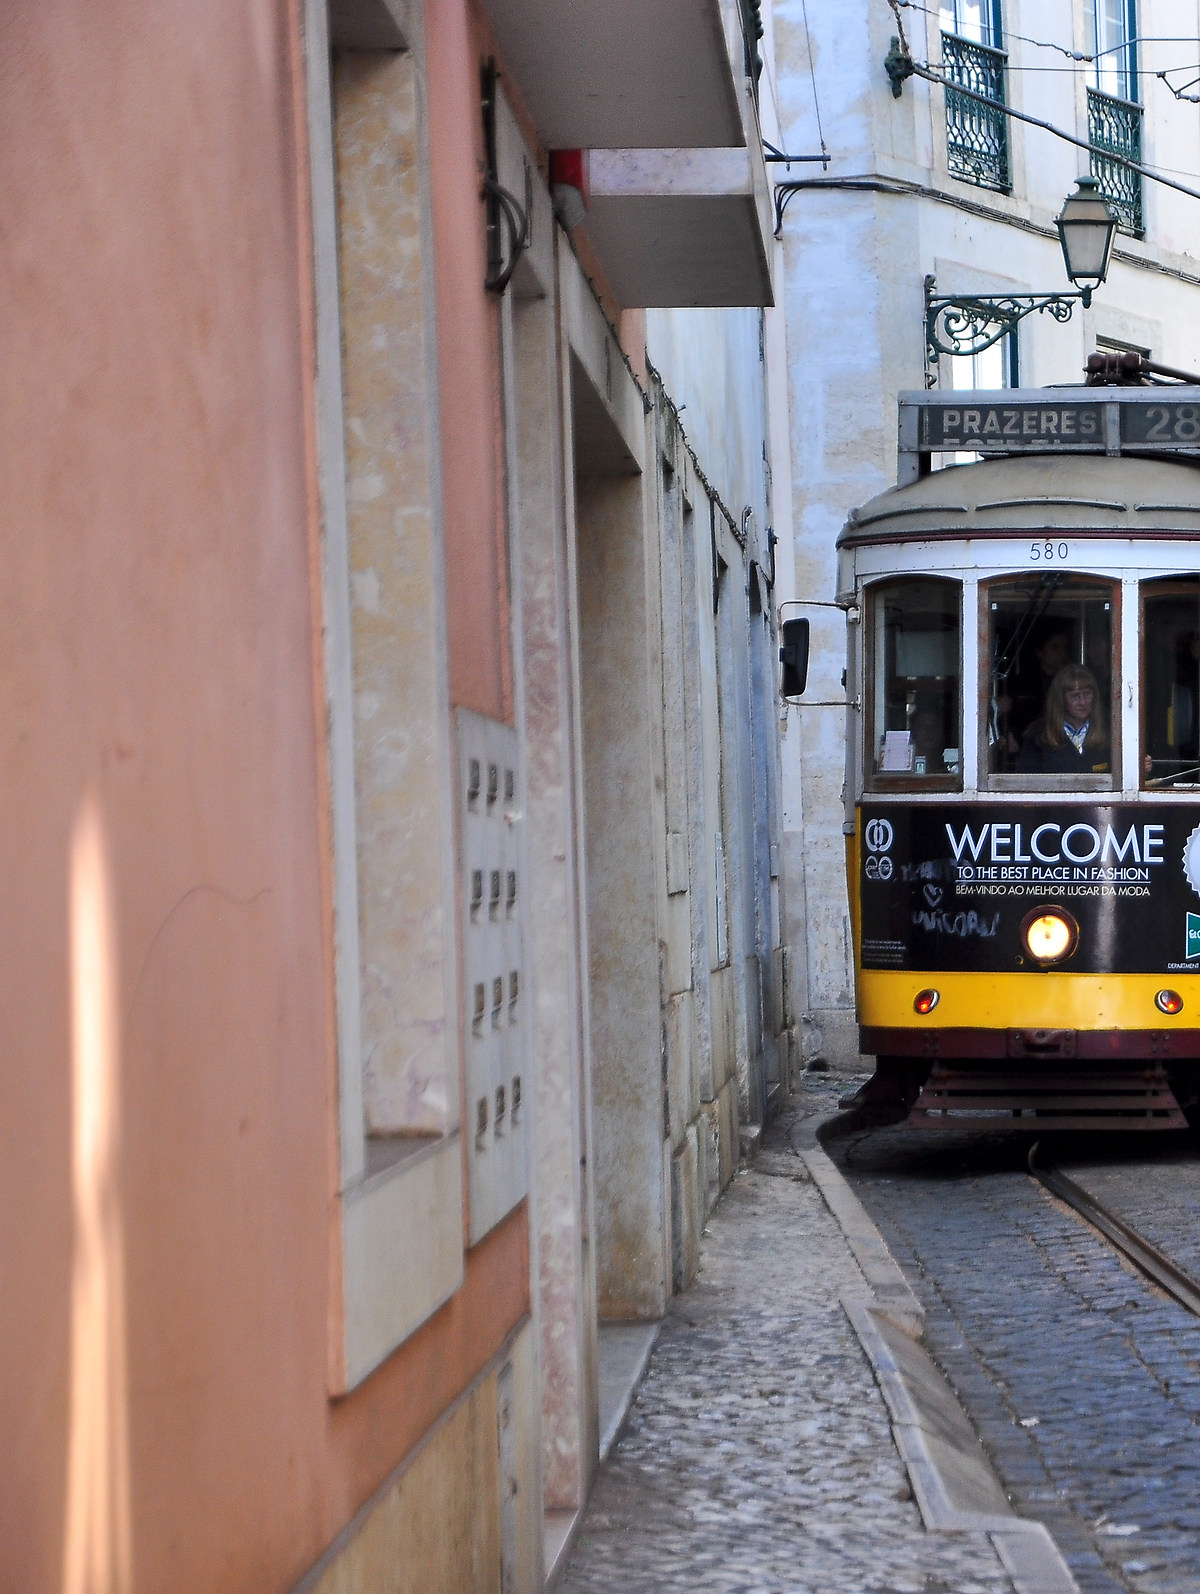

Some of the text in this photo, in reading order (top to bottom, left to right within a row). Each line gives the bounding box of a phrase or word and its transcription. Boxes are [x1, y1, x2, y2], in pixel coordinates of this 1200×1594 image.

[943, 405, 1200, 440] PRAZERES 28
[1030, 543, 1068, 560] 580
[945, 823, 1164, 863] WELCOME
[957, 866, 974, 879] TO
[976, 866, 998, 879] THE
[1001, 866, 1028, 879] BEST
[1032, 867, 1070, 880] PLACE
[1073, 867, 1088, 880] IN
[1091, 867, 1149, 880] FASHION
[956, 885, 1150, 897] BEM-VINDO AO MELHOR LUGAR DA MODA
[1189, 929, 1197, 939] El
